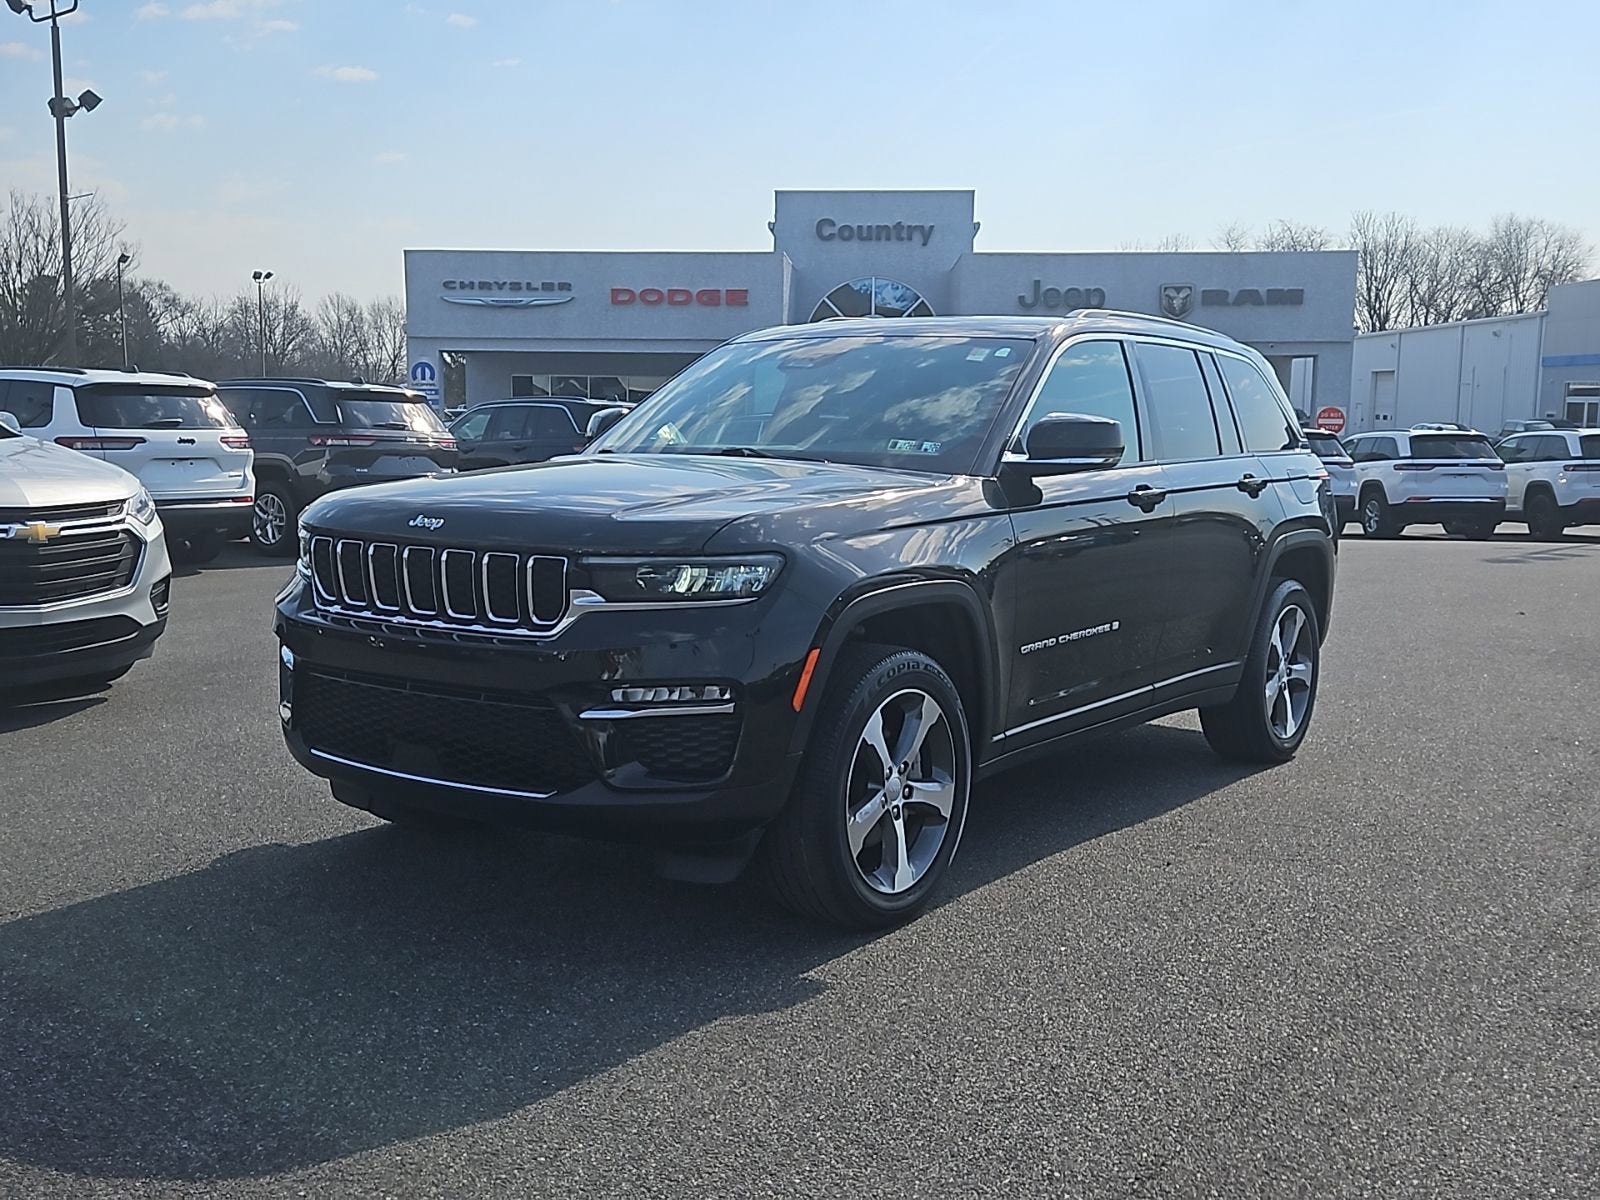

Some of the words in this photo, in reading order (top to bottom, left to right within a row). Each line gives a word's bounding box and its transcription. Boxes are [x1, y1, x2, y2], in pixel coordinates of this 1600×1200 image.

[816, 218, 935, 247] Country
[442, 280, 573, 292] CHRYSLER
[1018, 279, 1106, 309] Jeep
[610, 287, 749, 306] DODGE
[1200, 288, 1304, 306] RAM
[408, 514, 445, 531] Jeep
[1020, 637, 1057, 654] GRAND
[1058, 623, 1111, 644] CHEROKEE
